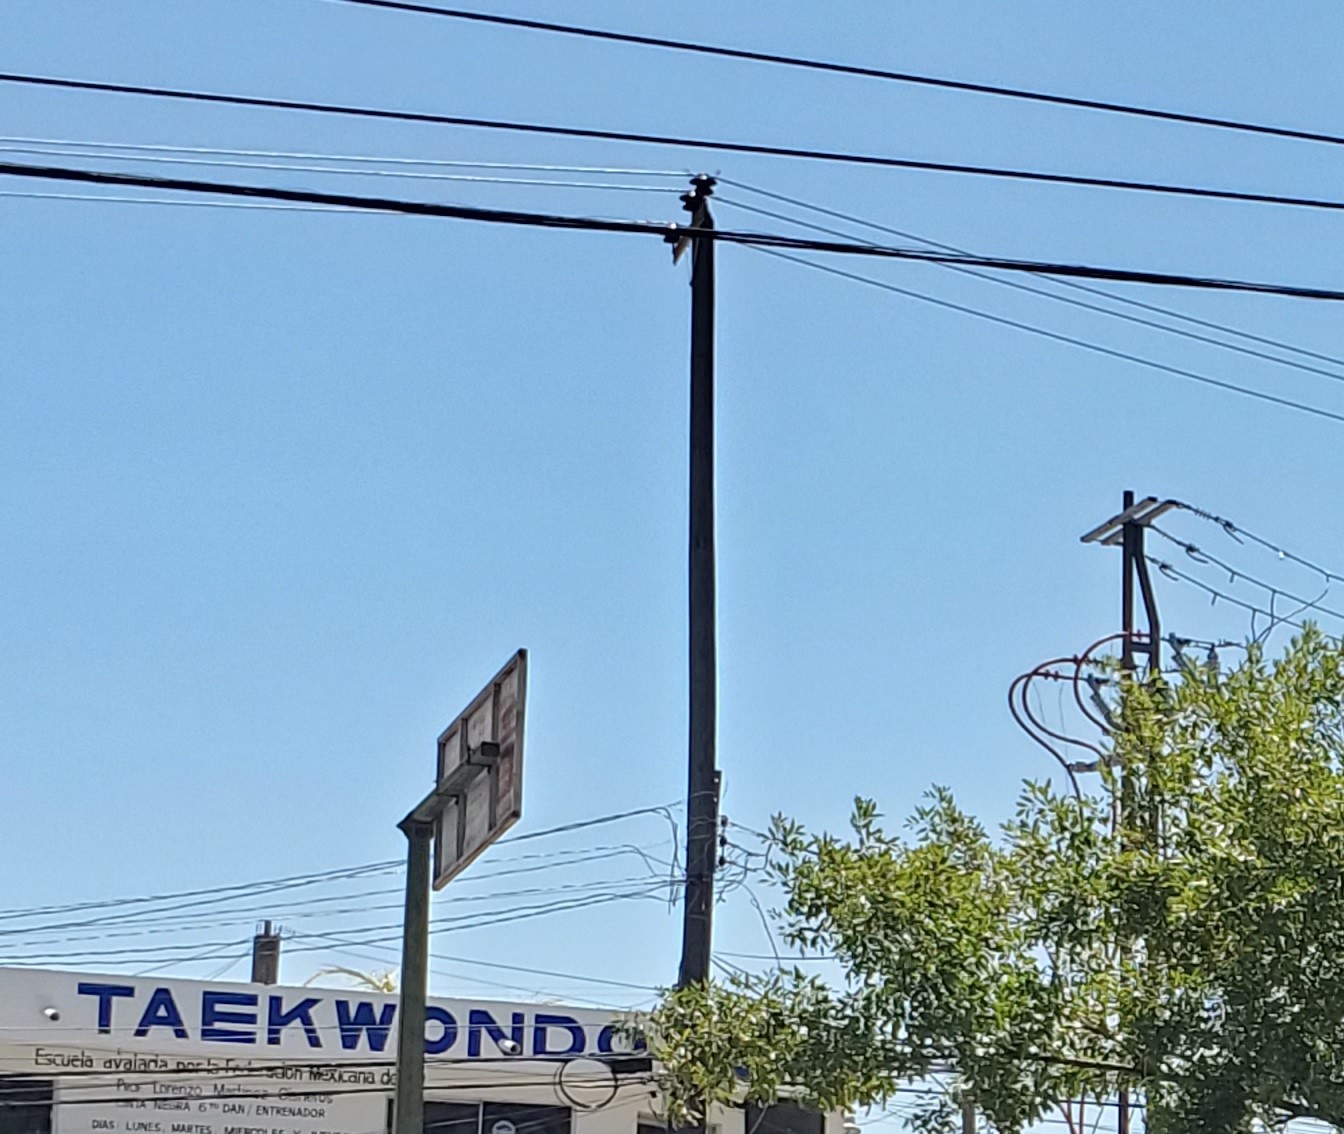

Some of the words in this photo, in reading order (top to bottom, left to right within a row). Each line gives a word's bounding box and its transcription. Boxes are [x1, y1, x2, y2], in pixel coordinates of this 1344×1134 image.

[35, 1048, 94, 1069] Escuela
[153, 1081, 203, 1097] Lorenzo
[256, 1105, 325, 1119] ENTRENADOR
